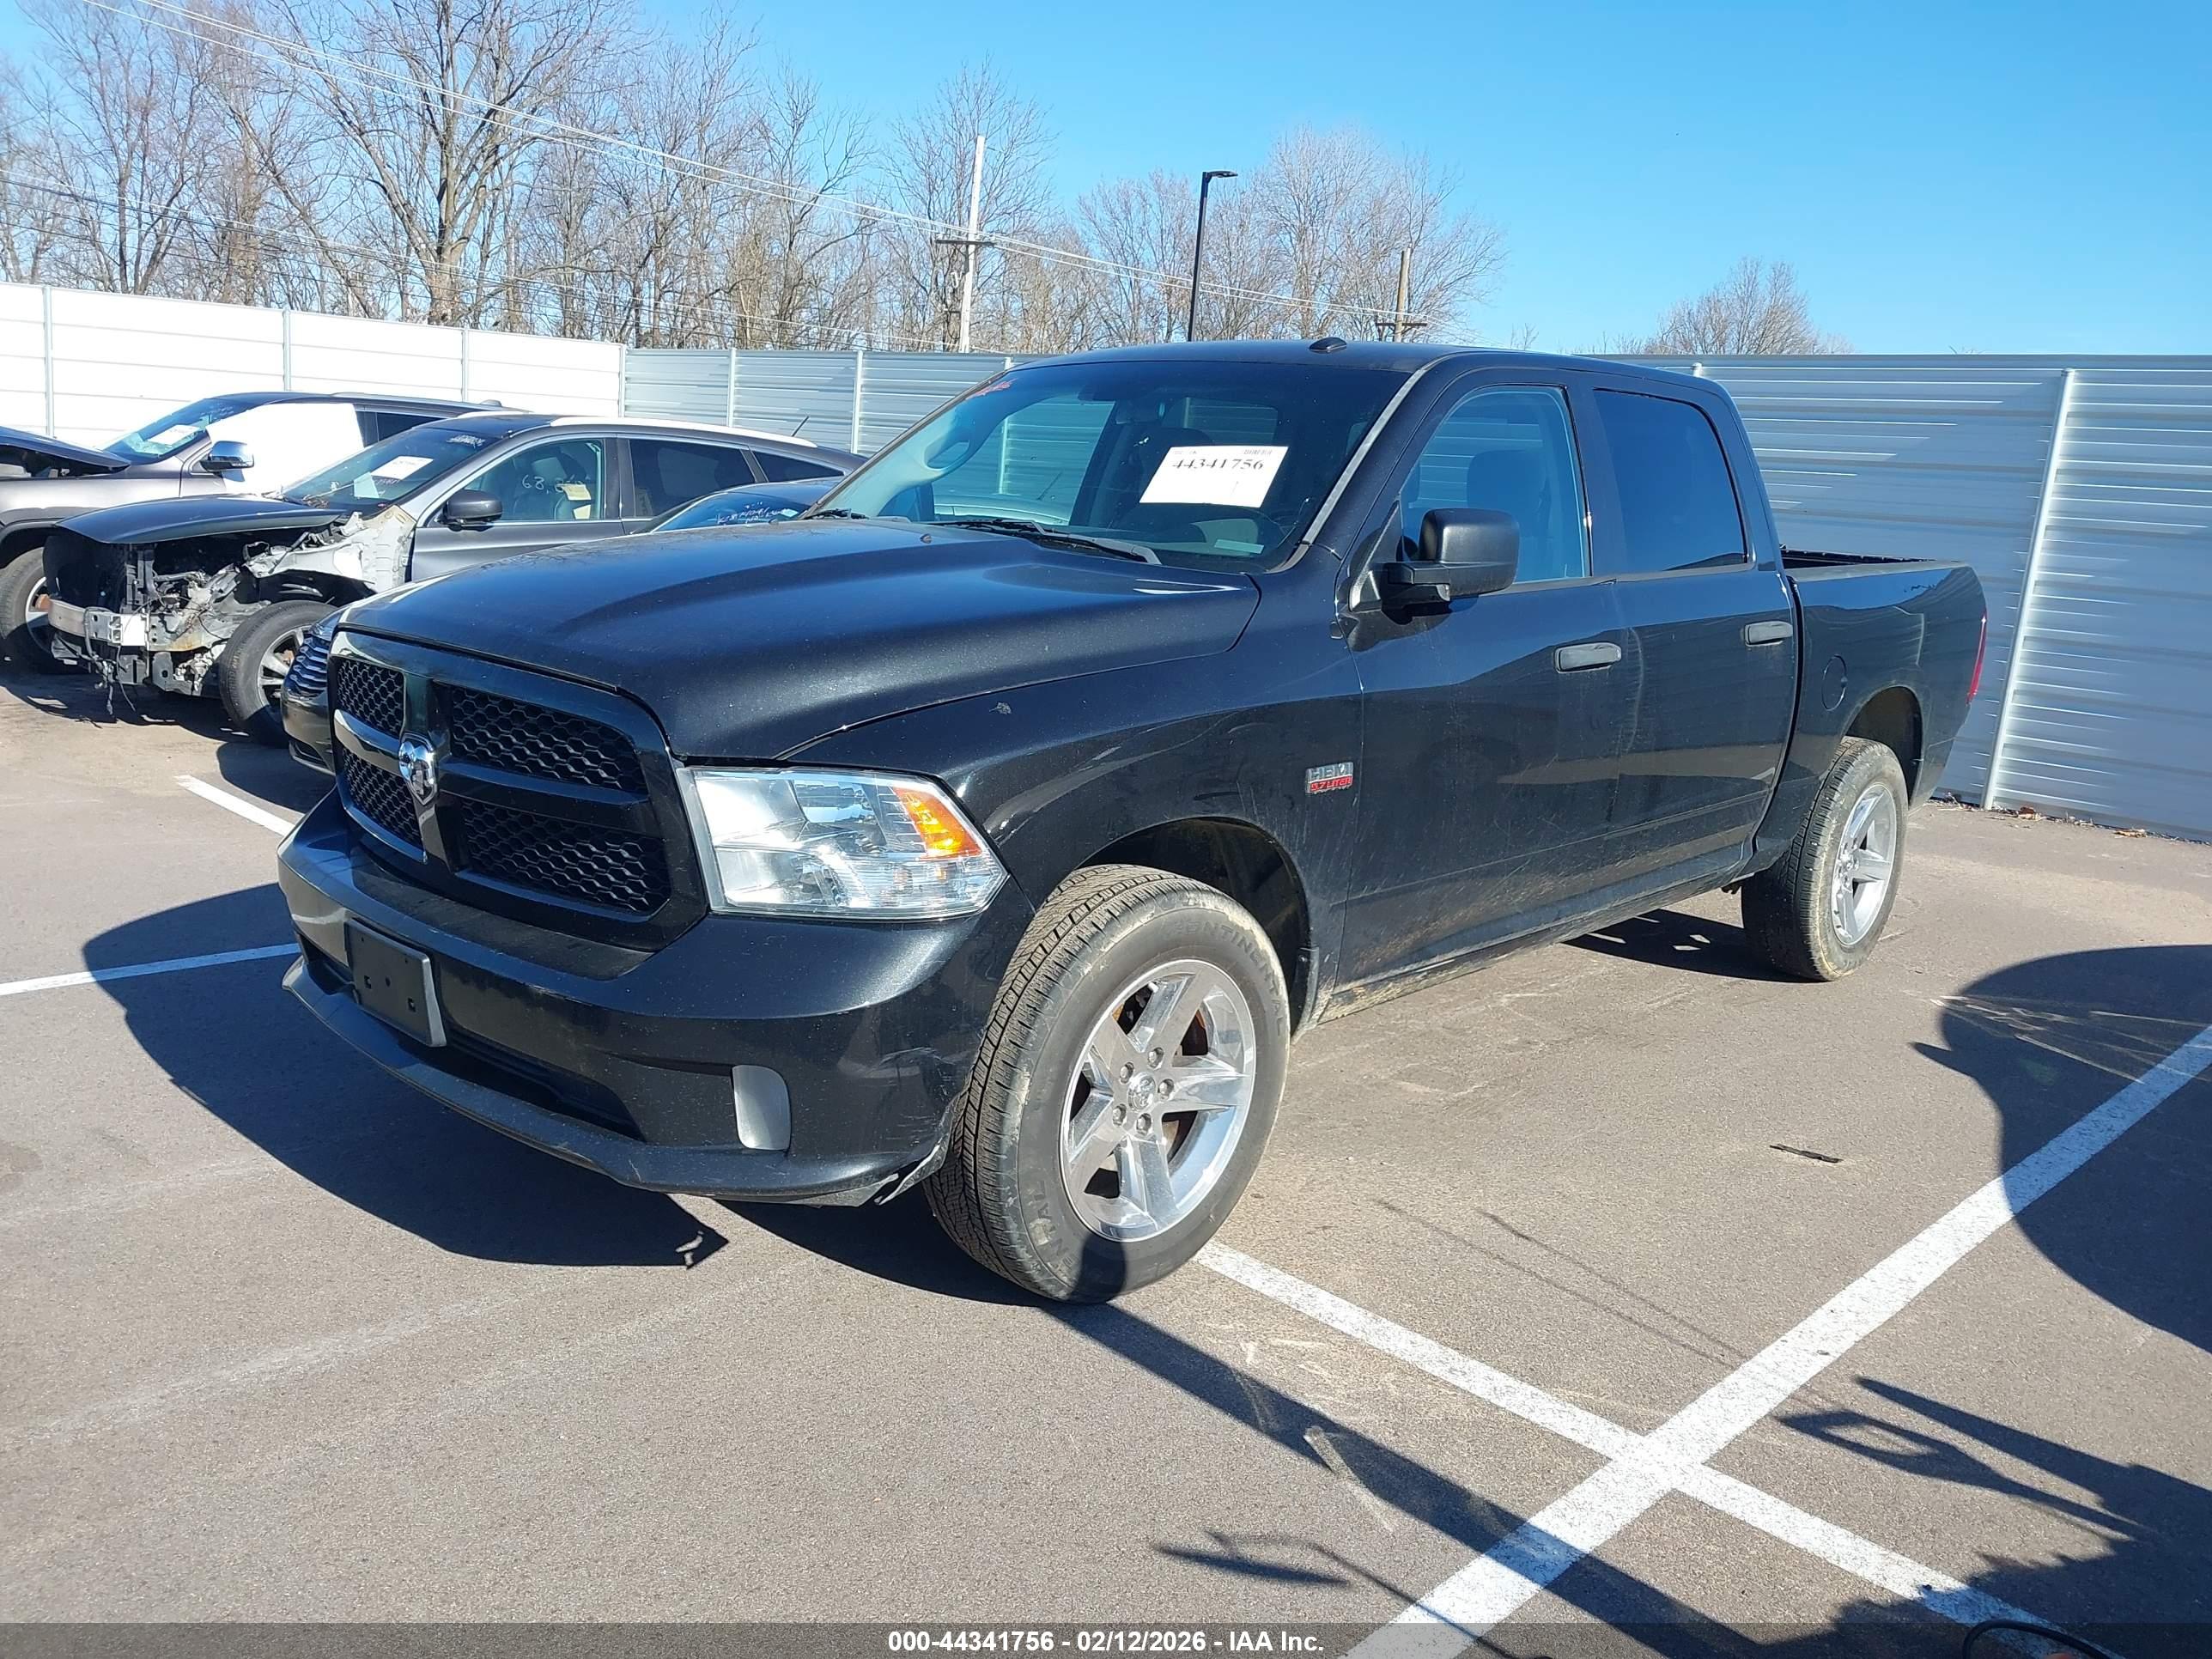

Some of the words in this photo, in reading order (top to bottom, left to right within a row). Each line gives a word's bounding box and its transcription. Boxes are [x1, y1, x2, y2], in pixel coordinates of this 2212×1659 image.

[1172, 459, 1265, 470] 44341756
[1308, 763, 1353, 782] HEMI
[1327, 777, 1352, 788] LITER
